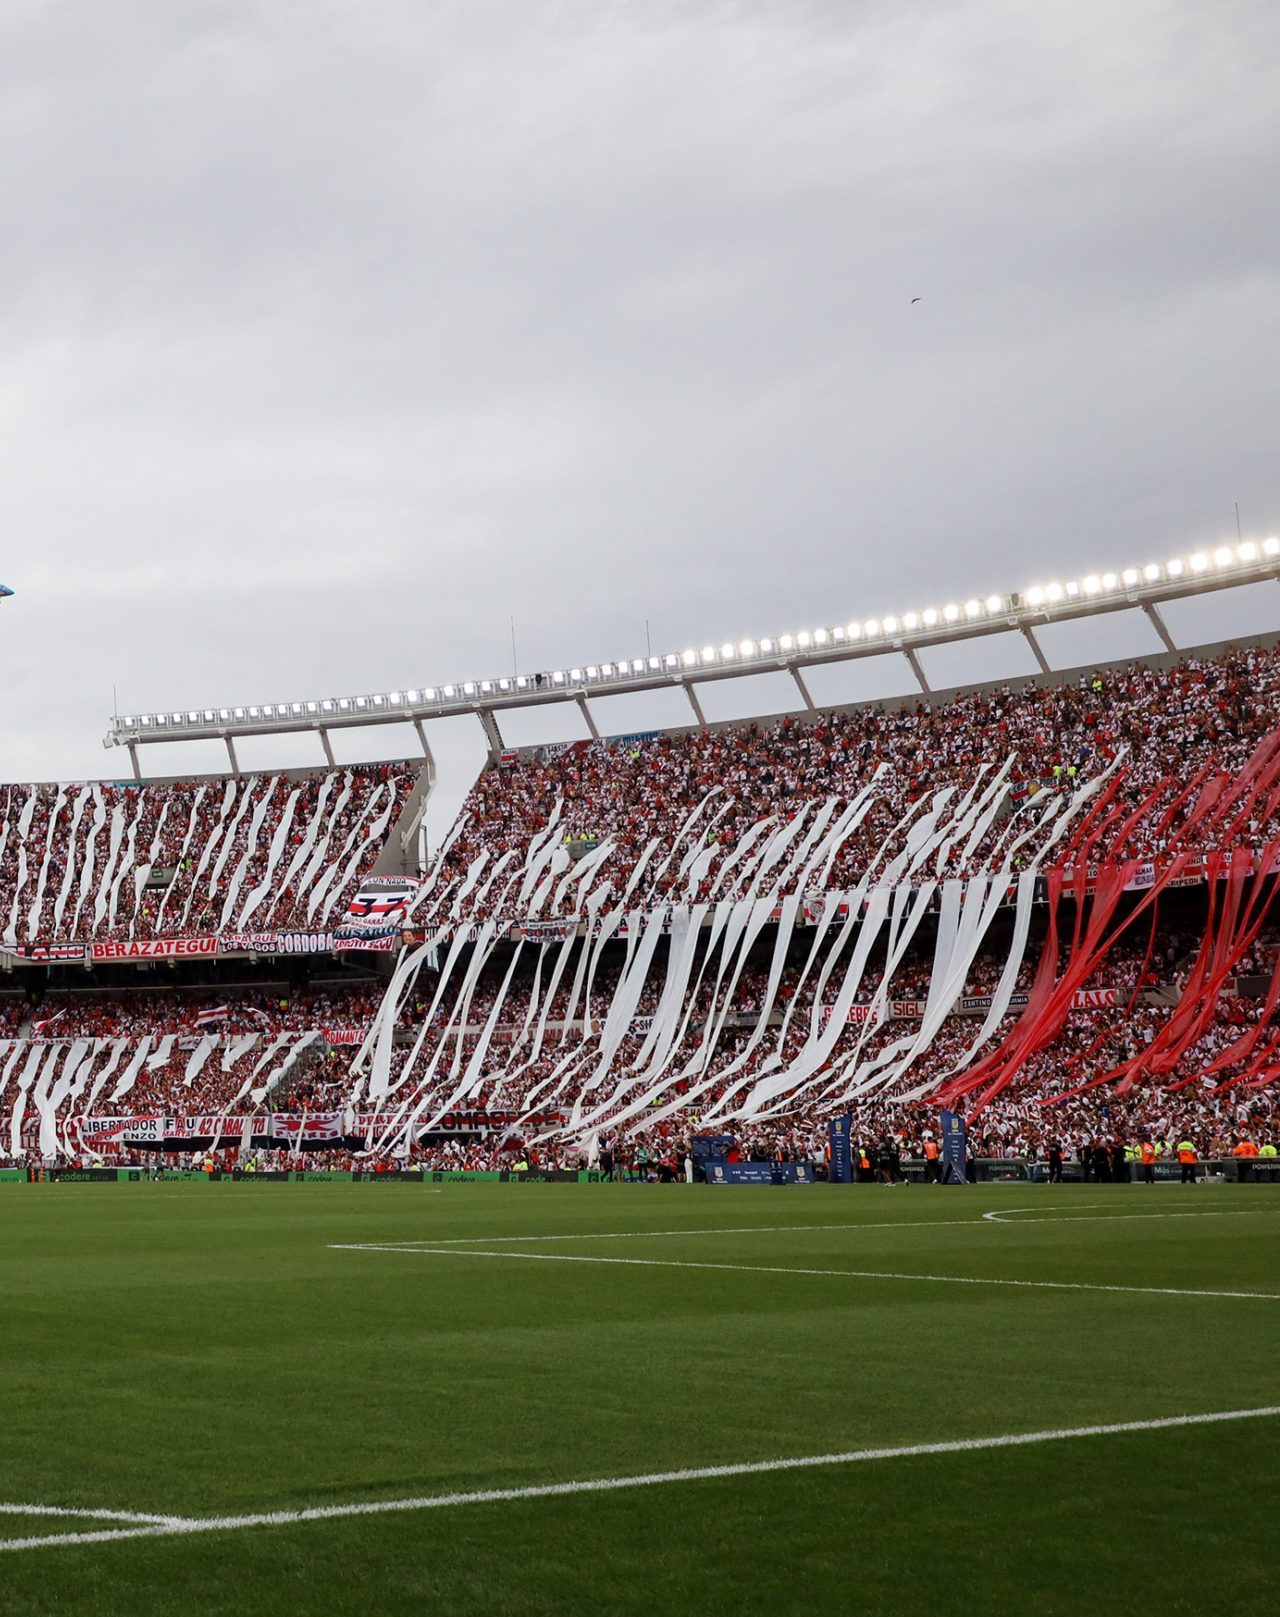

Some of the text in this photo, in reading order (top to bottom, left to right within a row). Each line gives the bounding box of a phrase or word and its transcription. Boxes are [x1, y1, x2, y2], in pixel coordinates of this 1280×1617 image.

[94, 938, 217, 957] BERAZATEGUI
[222, 942, 276, 953] LOS VAGOS
[274, 1113, 340, 1121] MARCELO
[81, 1118, 157, 1133] LIBERTADOR
[166, 1118, 195, 1131] FAU
[198, 1117, 212, 1136] 42
[82, 1131, 157, 1141] NICO ENZO
